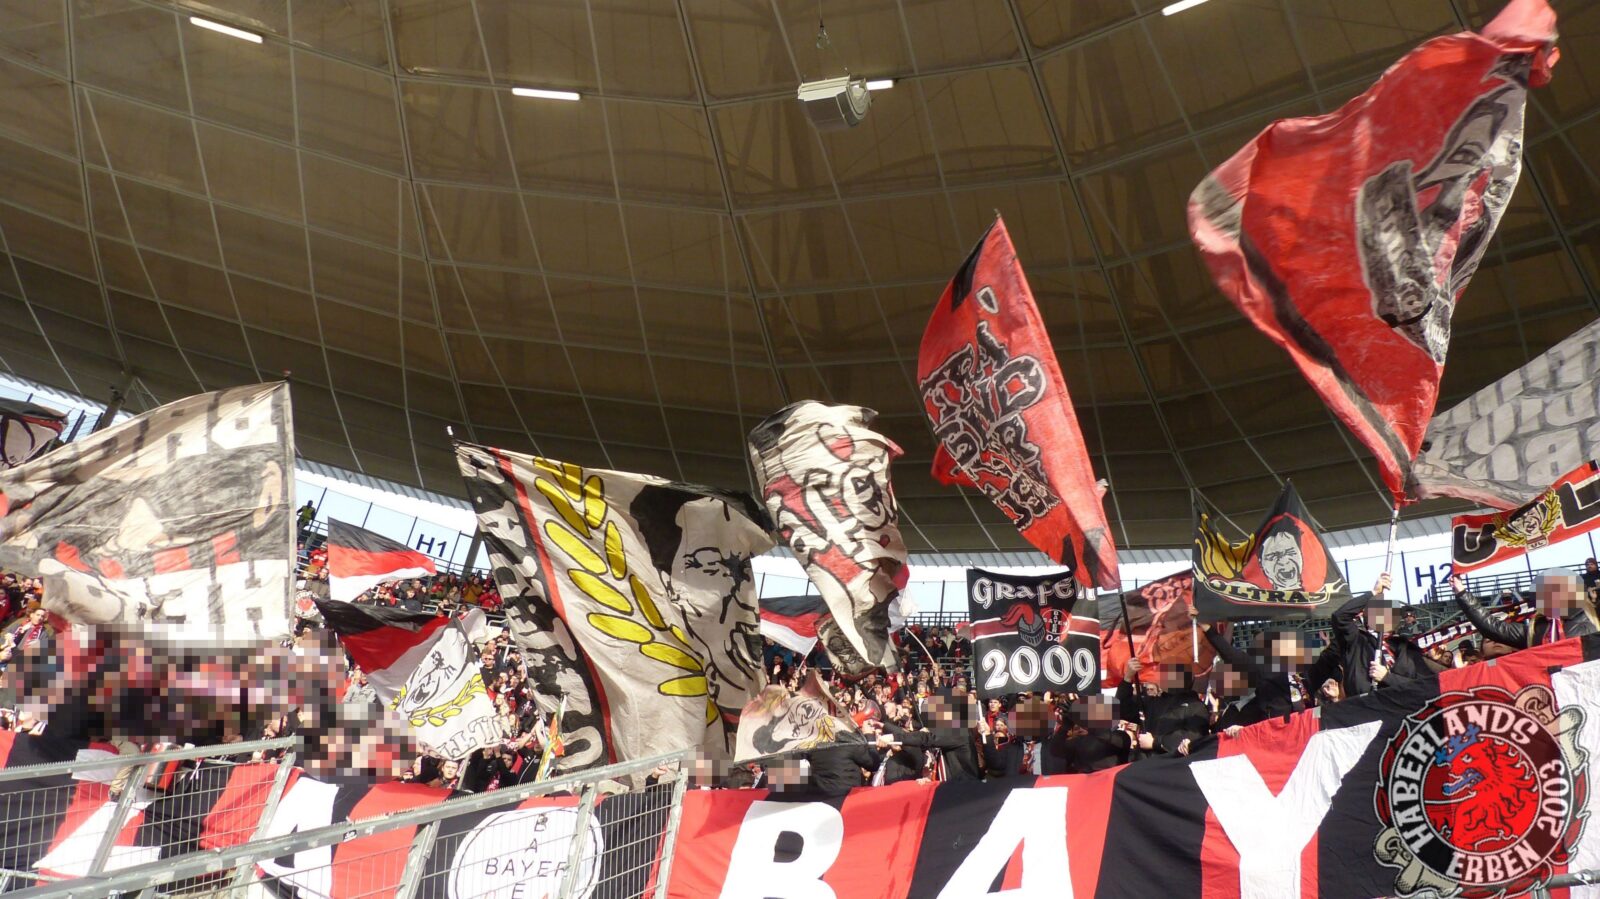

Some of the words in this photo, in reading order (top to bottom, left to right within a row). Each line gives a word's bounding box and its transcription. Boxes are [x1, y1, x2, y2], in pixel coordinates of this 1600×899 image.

[416, 533, 448, 557] H1
[1415, 563, 1452, 587] H2
[981, 645, 1097, 691] 2009
